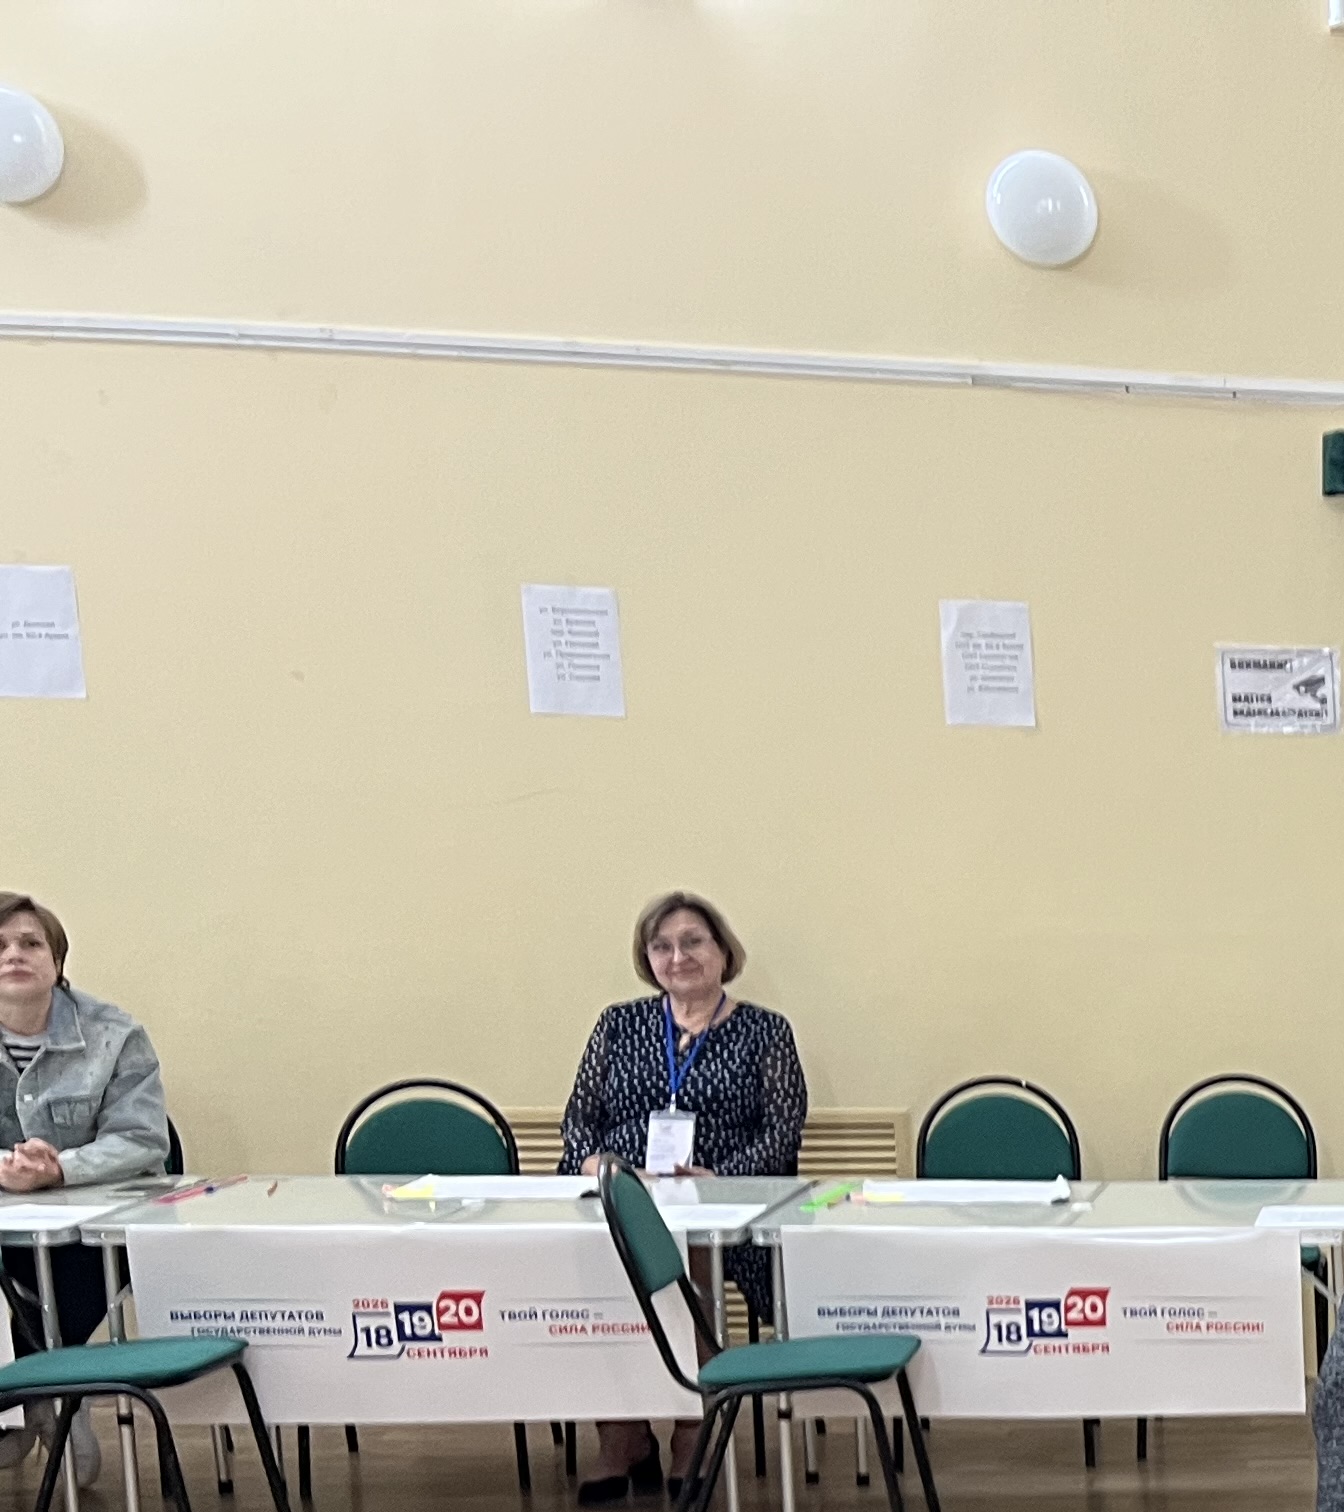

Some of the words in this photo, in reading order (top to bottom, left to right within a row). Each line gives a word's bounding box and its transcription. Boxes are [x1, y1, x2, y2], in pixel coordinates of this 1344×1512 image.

[352, 1298, 389, 1310] 2026
[986, 1295, 1021, 1306] 2026
[439, 1298, 480, 1325] 20
[499, 1306, 538, 1320] ТВОЙ
[541, 1308, 590, 1320] ГОЛОС
[817, 1306, 878, 1318] ВЫБОРЫ
[881, 1306, 960, 1318] ДЕПУТАТОВ
[1066, 1295, 1104, 1321] 20
[1121, 1304, 1157, 1318] ТВОЙ
[1160, 1306, 1205, 1319] ГОЛОС
[170, 1310, 236, 1321] ВЫБОРЫ
[239, 1310, 325, 1321] ДЕПУТАТОВ
[1028, 1306, 1060, 1334] 19
[398, 1309, 433, 1338] 19
[549, 1323, 588, 1335] СИЛА
[1165, 1321, 1203, 1333] СИЛА
[1205, 1321, 1265, 1333] РОССИИ!
[360, 1325, 394, 1348] 18
[993, 1321, 1023, 1344] 18
[406, 1347, 489, 1358] СЕНТЯБРЯ
[1033, 1343, 1110, 1355] СЕНТЯБРЯ
